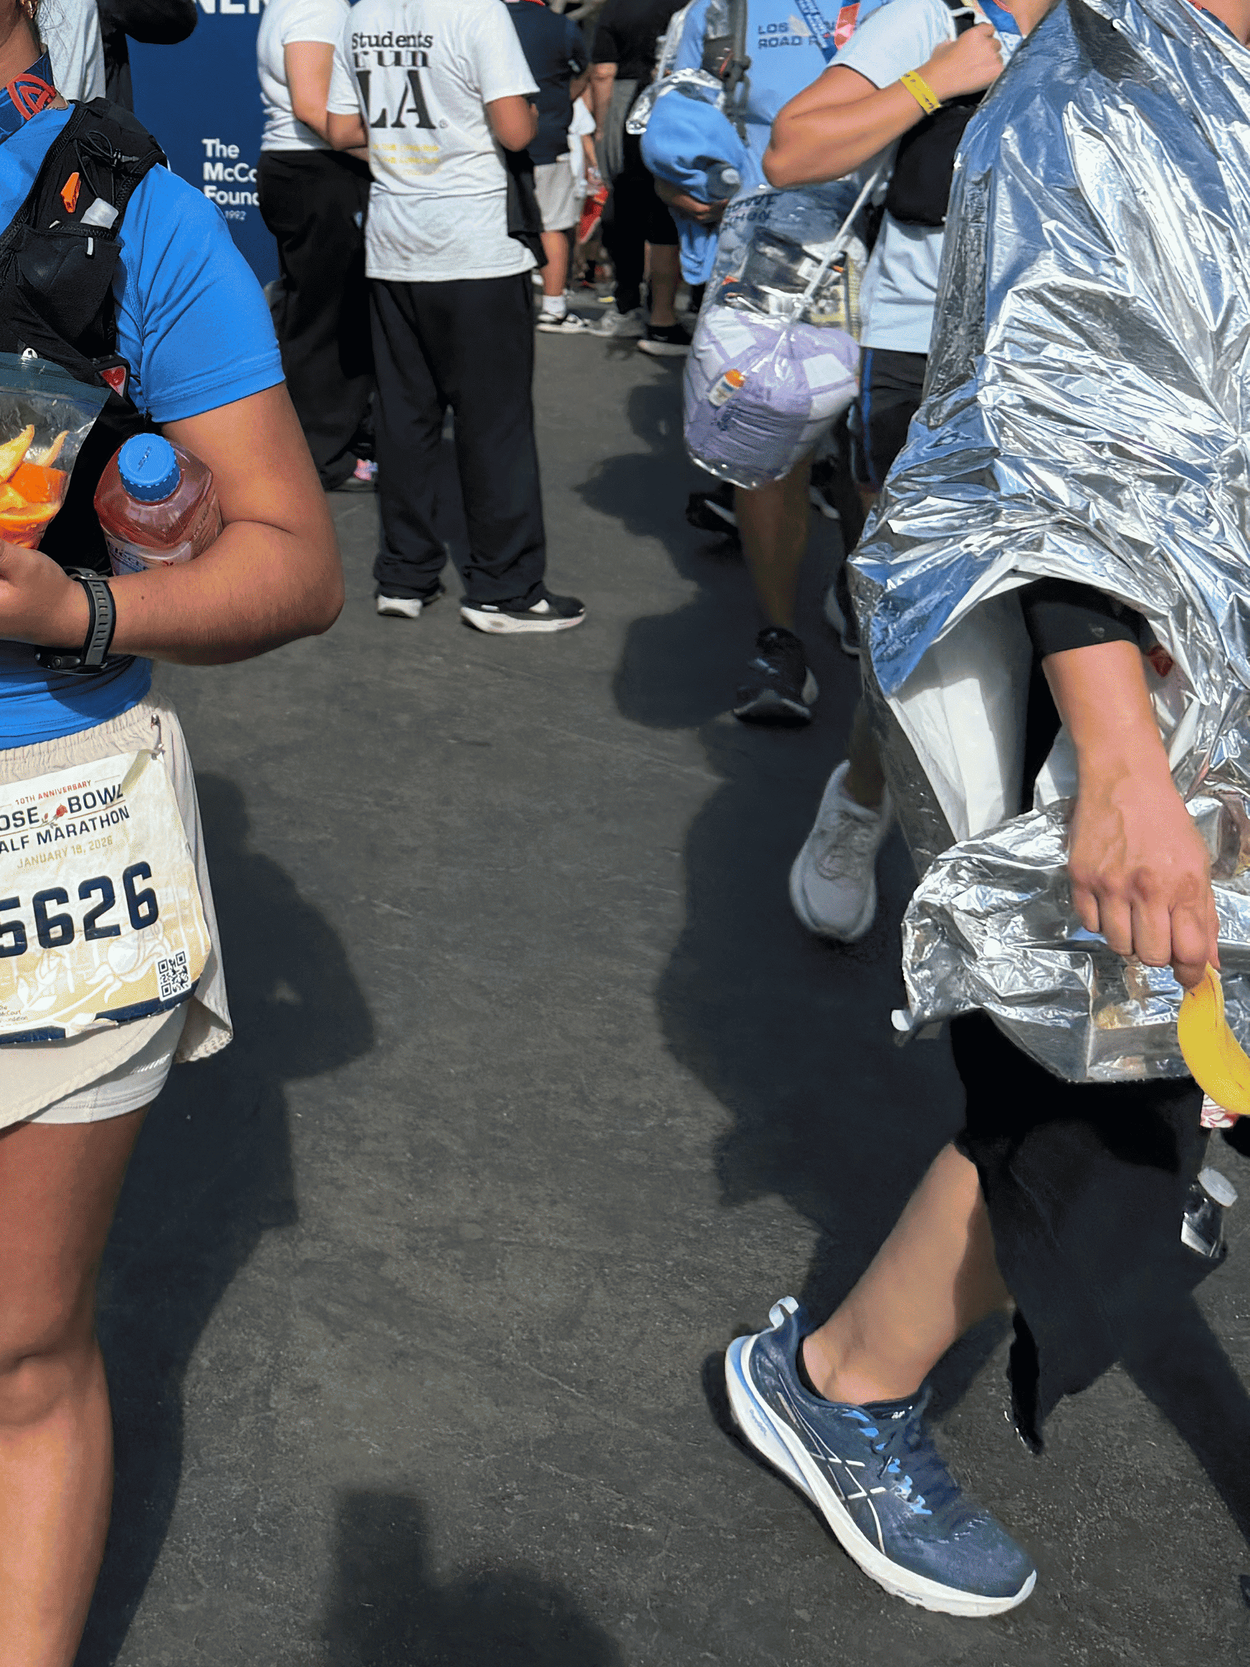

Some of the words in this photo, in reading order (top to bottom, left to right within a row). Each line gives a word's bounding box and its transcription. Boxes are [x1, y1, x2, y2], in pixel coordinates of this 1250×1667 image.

[351, 31, 433, 49] Students
[758, 22, 789, 35] LOS
[758, 35, 802, 50] ROAD
[352, 50, 431, 68] run
[356, 70, 437, 129] LA
[201, 138, 240, 159] The
[14, 795, 36, 806] 10TH
[38, 780, 92, 800] ANNIVERSARY
[67, 783, 124, 814] BOWL
[36, 806, 130, 845] MARATHON
[17, 848, 68, 869] JANUARY
[88, 835, 113, 851] 2026
